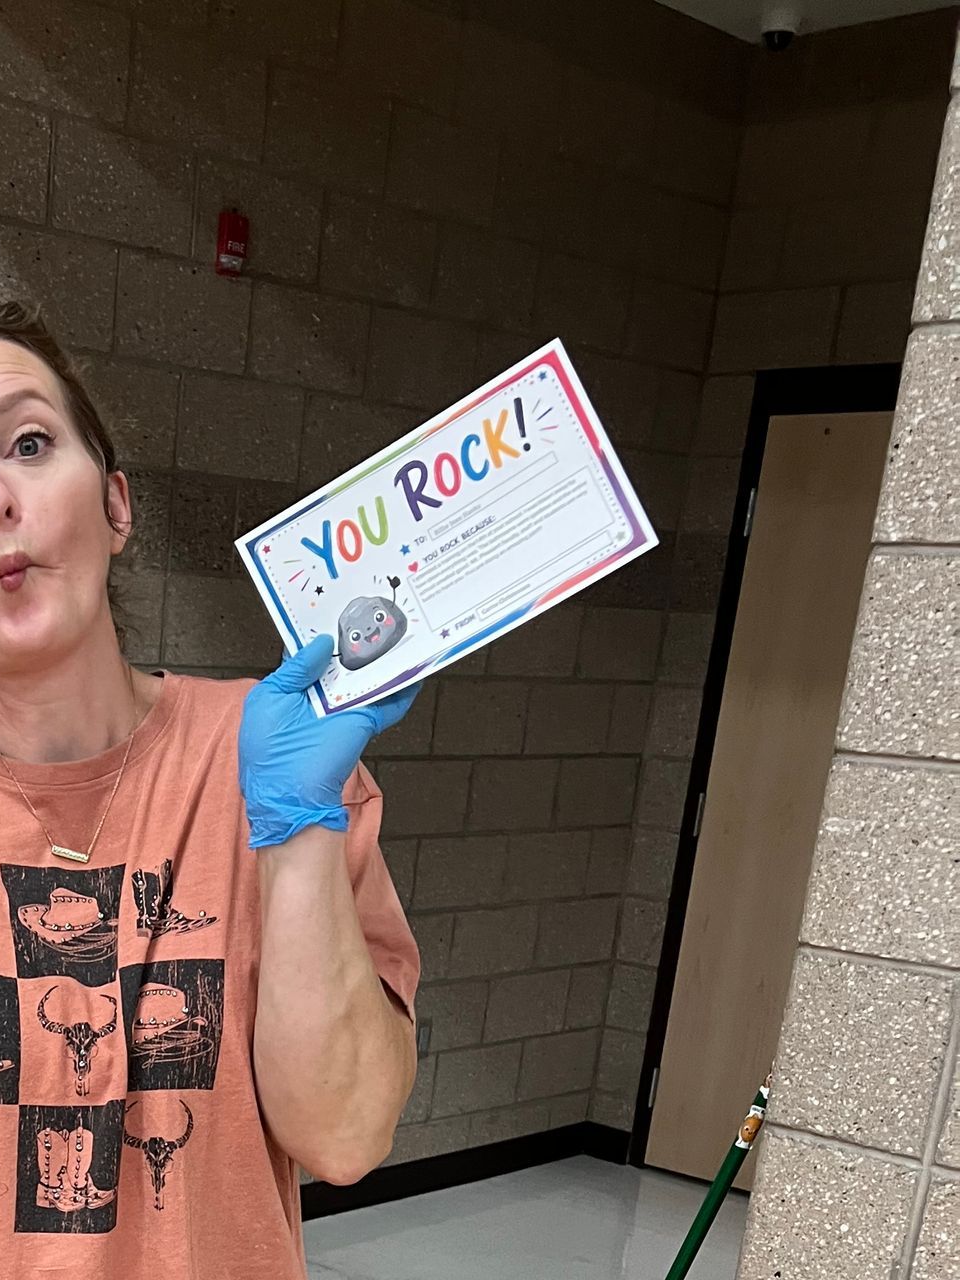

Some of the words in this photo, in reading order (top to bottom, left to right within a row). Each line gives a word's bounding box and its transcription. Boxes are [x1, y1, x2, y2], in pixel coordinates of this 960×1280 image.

[300, 495, 389, 580] YOU
[393, 397, 531, 522] ROCK!
[423, 550, 438, 563] YOU
[440, 537, 460, 553] ROCK
[460, 515, 496, 540] BECAUSE:
